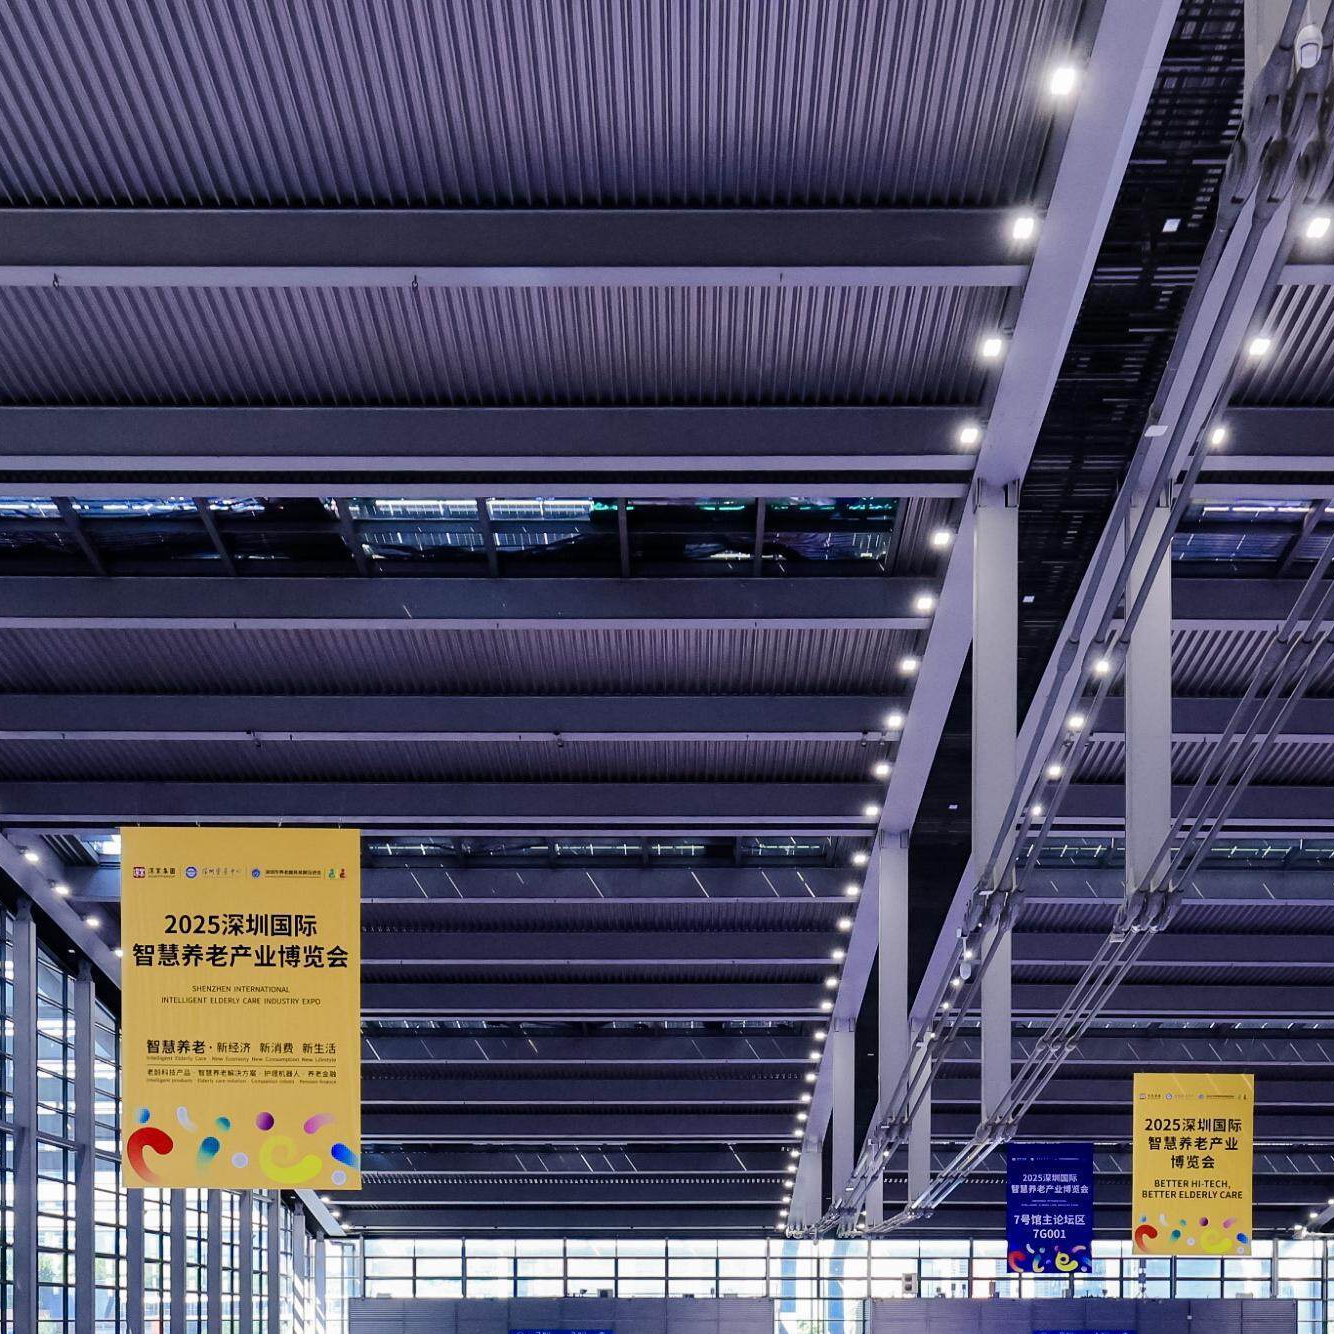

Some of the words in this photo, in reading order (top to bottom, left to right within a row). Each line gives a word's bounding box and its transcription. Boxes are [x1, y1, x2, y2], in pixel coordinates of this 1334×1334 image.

[164, 914, 317, 937] 2025深圳国际
[132, 943, 349, 968] 智慧养老产业博览会
[192, 985, 232, 993] SHENZHEN
[234, 985, 289, 993] INTERNATIONAL
[161, 997, 207, 1005] INTELLIGENT
[210, 997, 240, 1005] ELDERLY
[242, 997, 261, 1005] CARE
[264, 998, 299, 1006] INDUSTRY
[301, 998, 321, 1006] EXPO
[260, 1042, 294, 1054] 新消费
[302, 1043, 336, 1054] 新生活
[1145, 1118, 1242, 1132] 2025深圳国际
[1148, 1136, 1239, 1151] 智慧养老产业
[1170, 1155, 1215, 1169] 博览会
[1022, 1174, 1078, 1183] 2025深圳国际
[1011, 1184, 1089, 1194] 智慧养老产业博览会
[1154, 1180, 1189, 1188] BETTER
[1191, 1180, 1231, 1190] HI-TECH,
[1142, 1190, 1177, 1199] BETTER
[1179, 1190, 1217, 1199] ELDERLY
[1219, 1191, 1243, 1199] CARE
[1014, 1214, 1086, 1226] 7号馆主论坛区
[1033, 1229, 1066, 1239] 7G001
